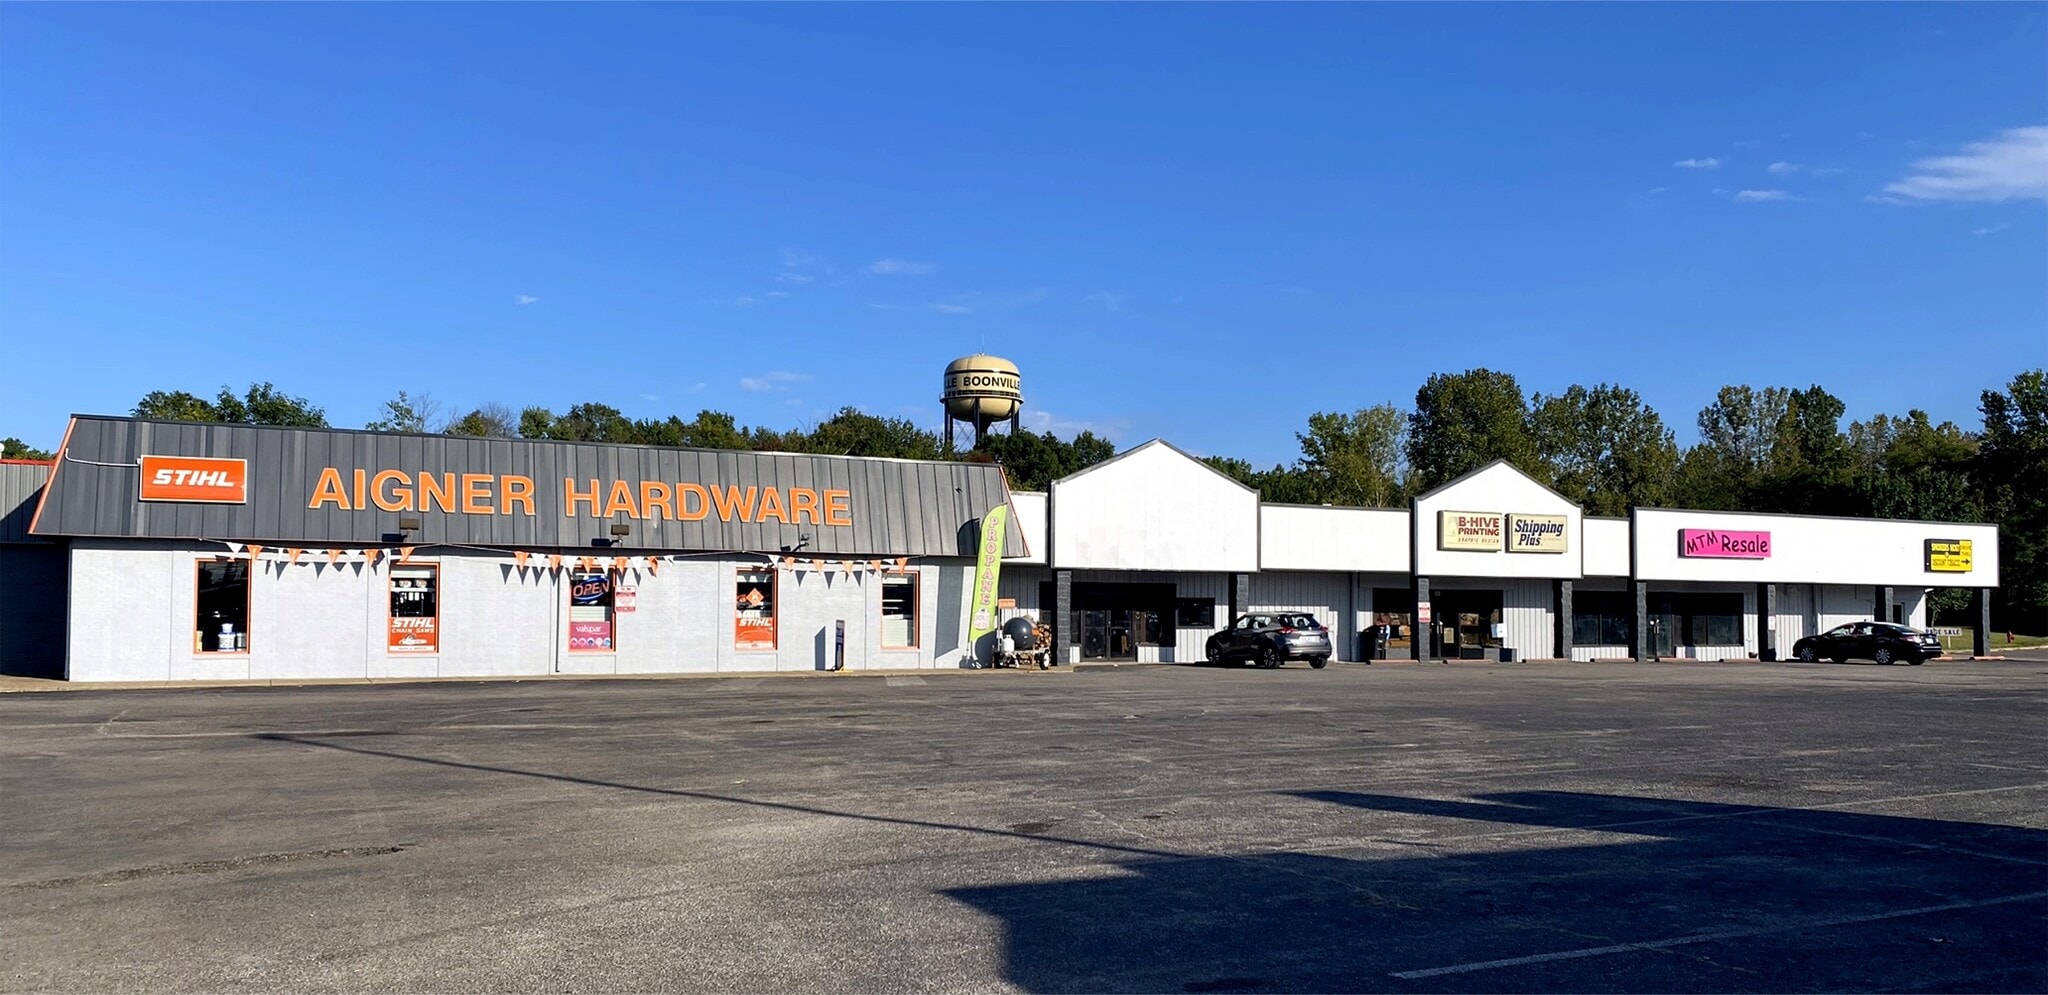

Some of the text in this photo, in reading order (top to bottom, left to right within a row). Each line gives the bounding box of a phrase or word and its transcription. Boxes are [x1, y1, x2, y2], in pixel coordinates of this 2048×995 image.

[963, 376, 1020, 390] BOONVILLE
[152, 468, 235, 487] STIHL
[308, 467, 852, 526] AIGNER HARDWARE
[1458, 516, 1500, 527] B-HIVE
[1515, 519, 1564, 536] Shipping
[1458, 527, 1500, 536] PRINTING
[1518, 533, 1542, 546] Plus
[1686, 530, 1769, 555] MTM Resale
[981, 517, 998, 605] PROPANE
[573, 581, 610, 597] OPEN
[391, 618, 435, 628] STIHL
[739, 618, 772, 627] STIHL
